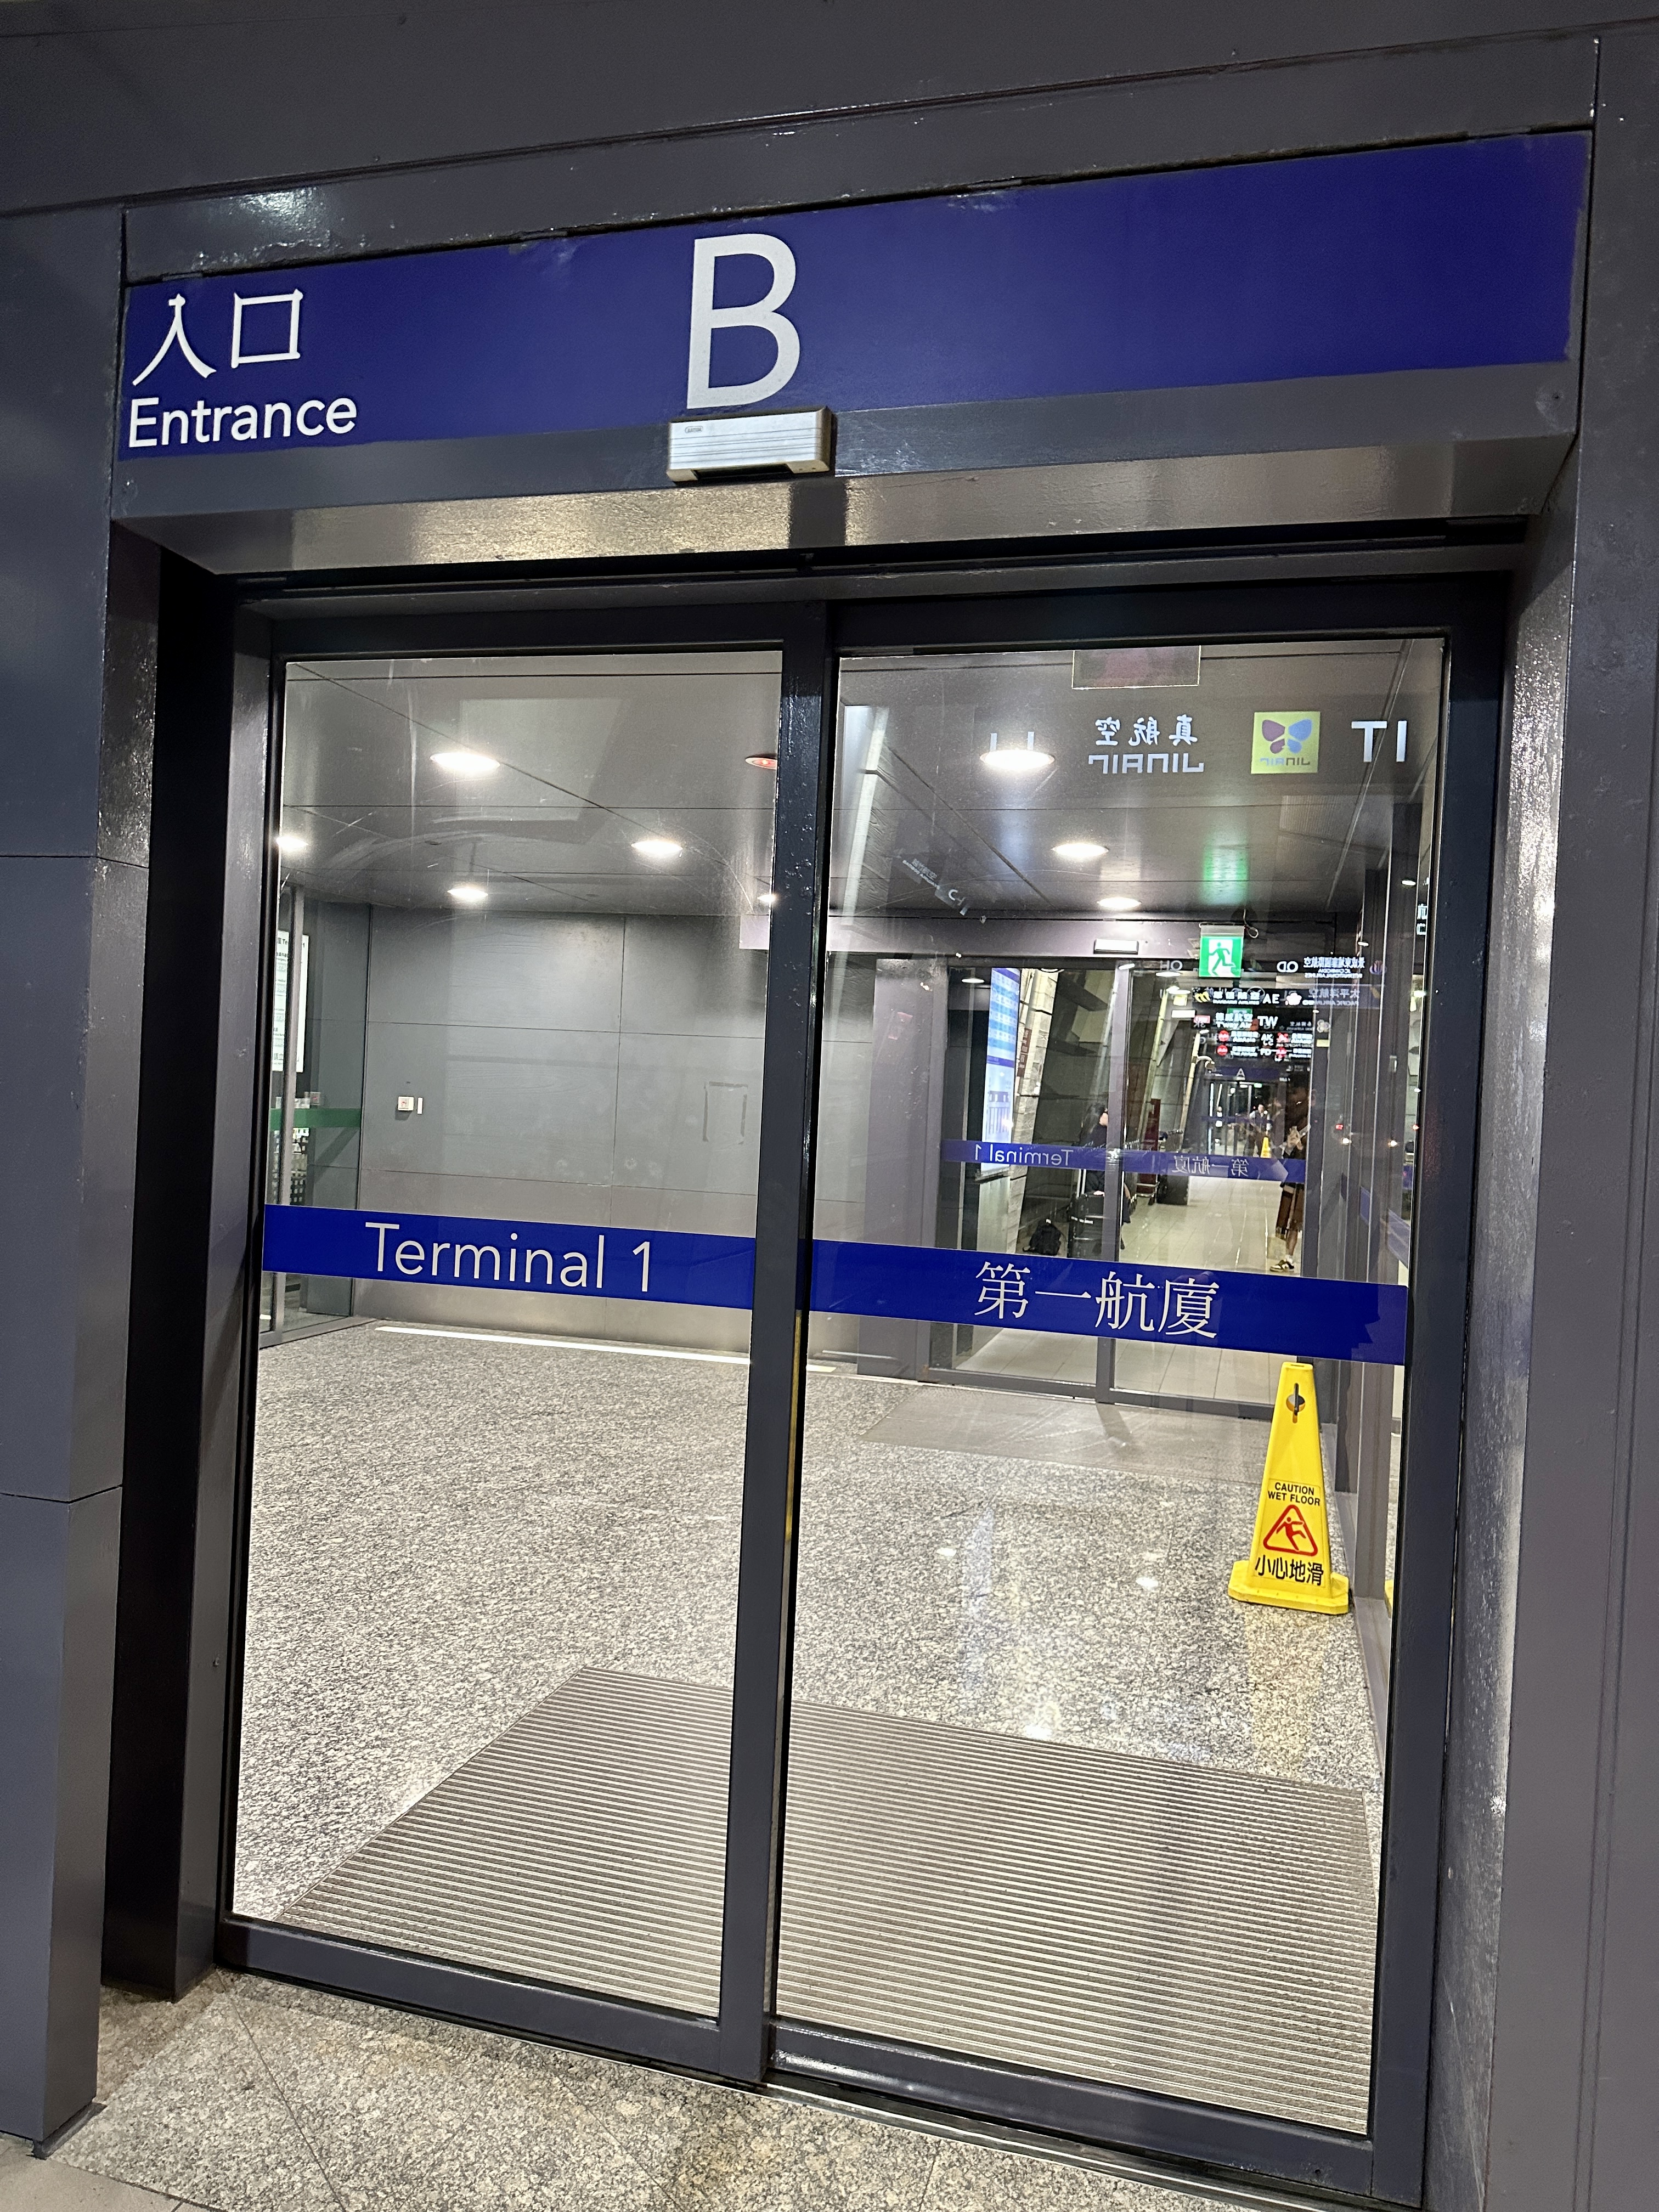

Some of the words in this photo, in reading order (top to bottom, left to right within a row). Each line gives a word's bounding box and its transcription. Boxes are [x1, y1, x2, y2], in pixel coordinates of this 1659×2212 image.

[132, 289, 303, 386] 入口
[687, 233, 801, 409] B
[129, 398, 357, 449] Entrance
[1262, 994, 1280, 1004] AE
[1257, 1015, 1278, 1027] TW
[365, 1222, 604, 1289] Terminal
[633, 1241, 650, 1292] 1
[974, 1261, 1219, 1339] 第一航廈
[1268, 1491, 1287, 1502] WET
[1290, 1494, 1321, 1506] FLOOR
[1274, 1482, 1314, 1495] CAUTION
[1255, 1555, 1324, 1586] 小心地滑
